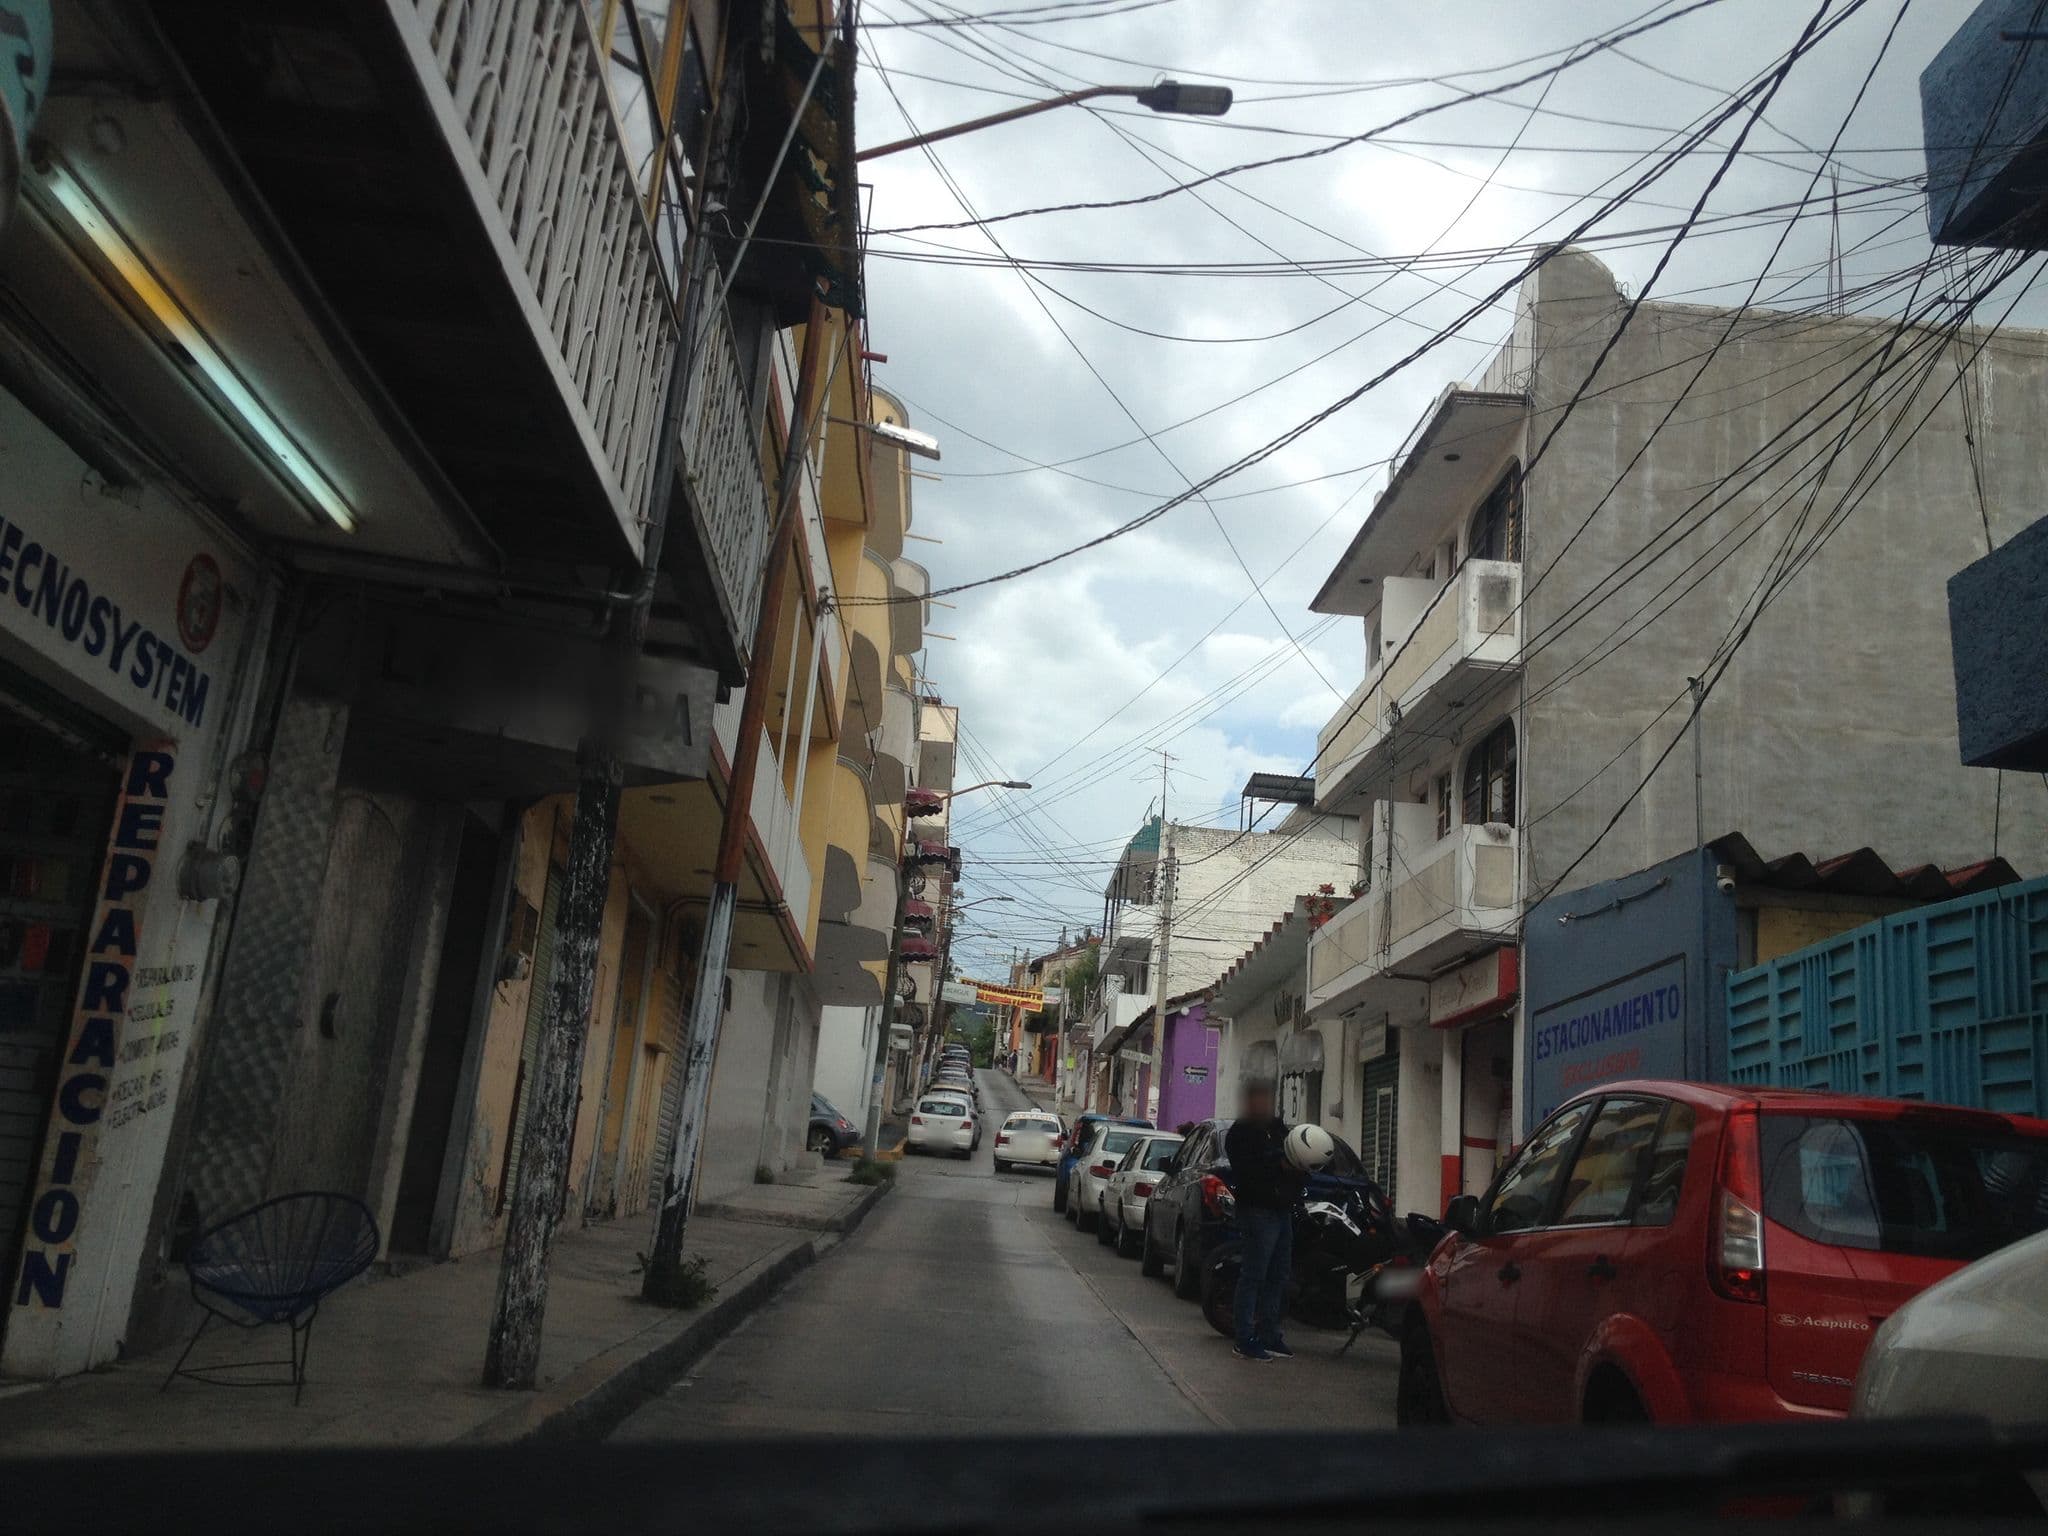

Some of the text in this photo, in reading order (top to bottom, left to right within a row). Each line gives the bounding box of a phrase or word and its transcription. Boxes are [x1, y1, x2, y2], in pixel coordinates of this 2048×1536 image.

[0, 516, 209, 727] ECNOSYSTEM
[17, 751, 176, 1308] REPARACION
[1536, 984, 1680, 1060] ESTACIONAMIENTO
[1803, 1316, 1869, 1331] Acapulco
